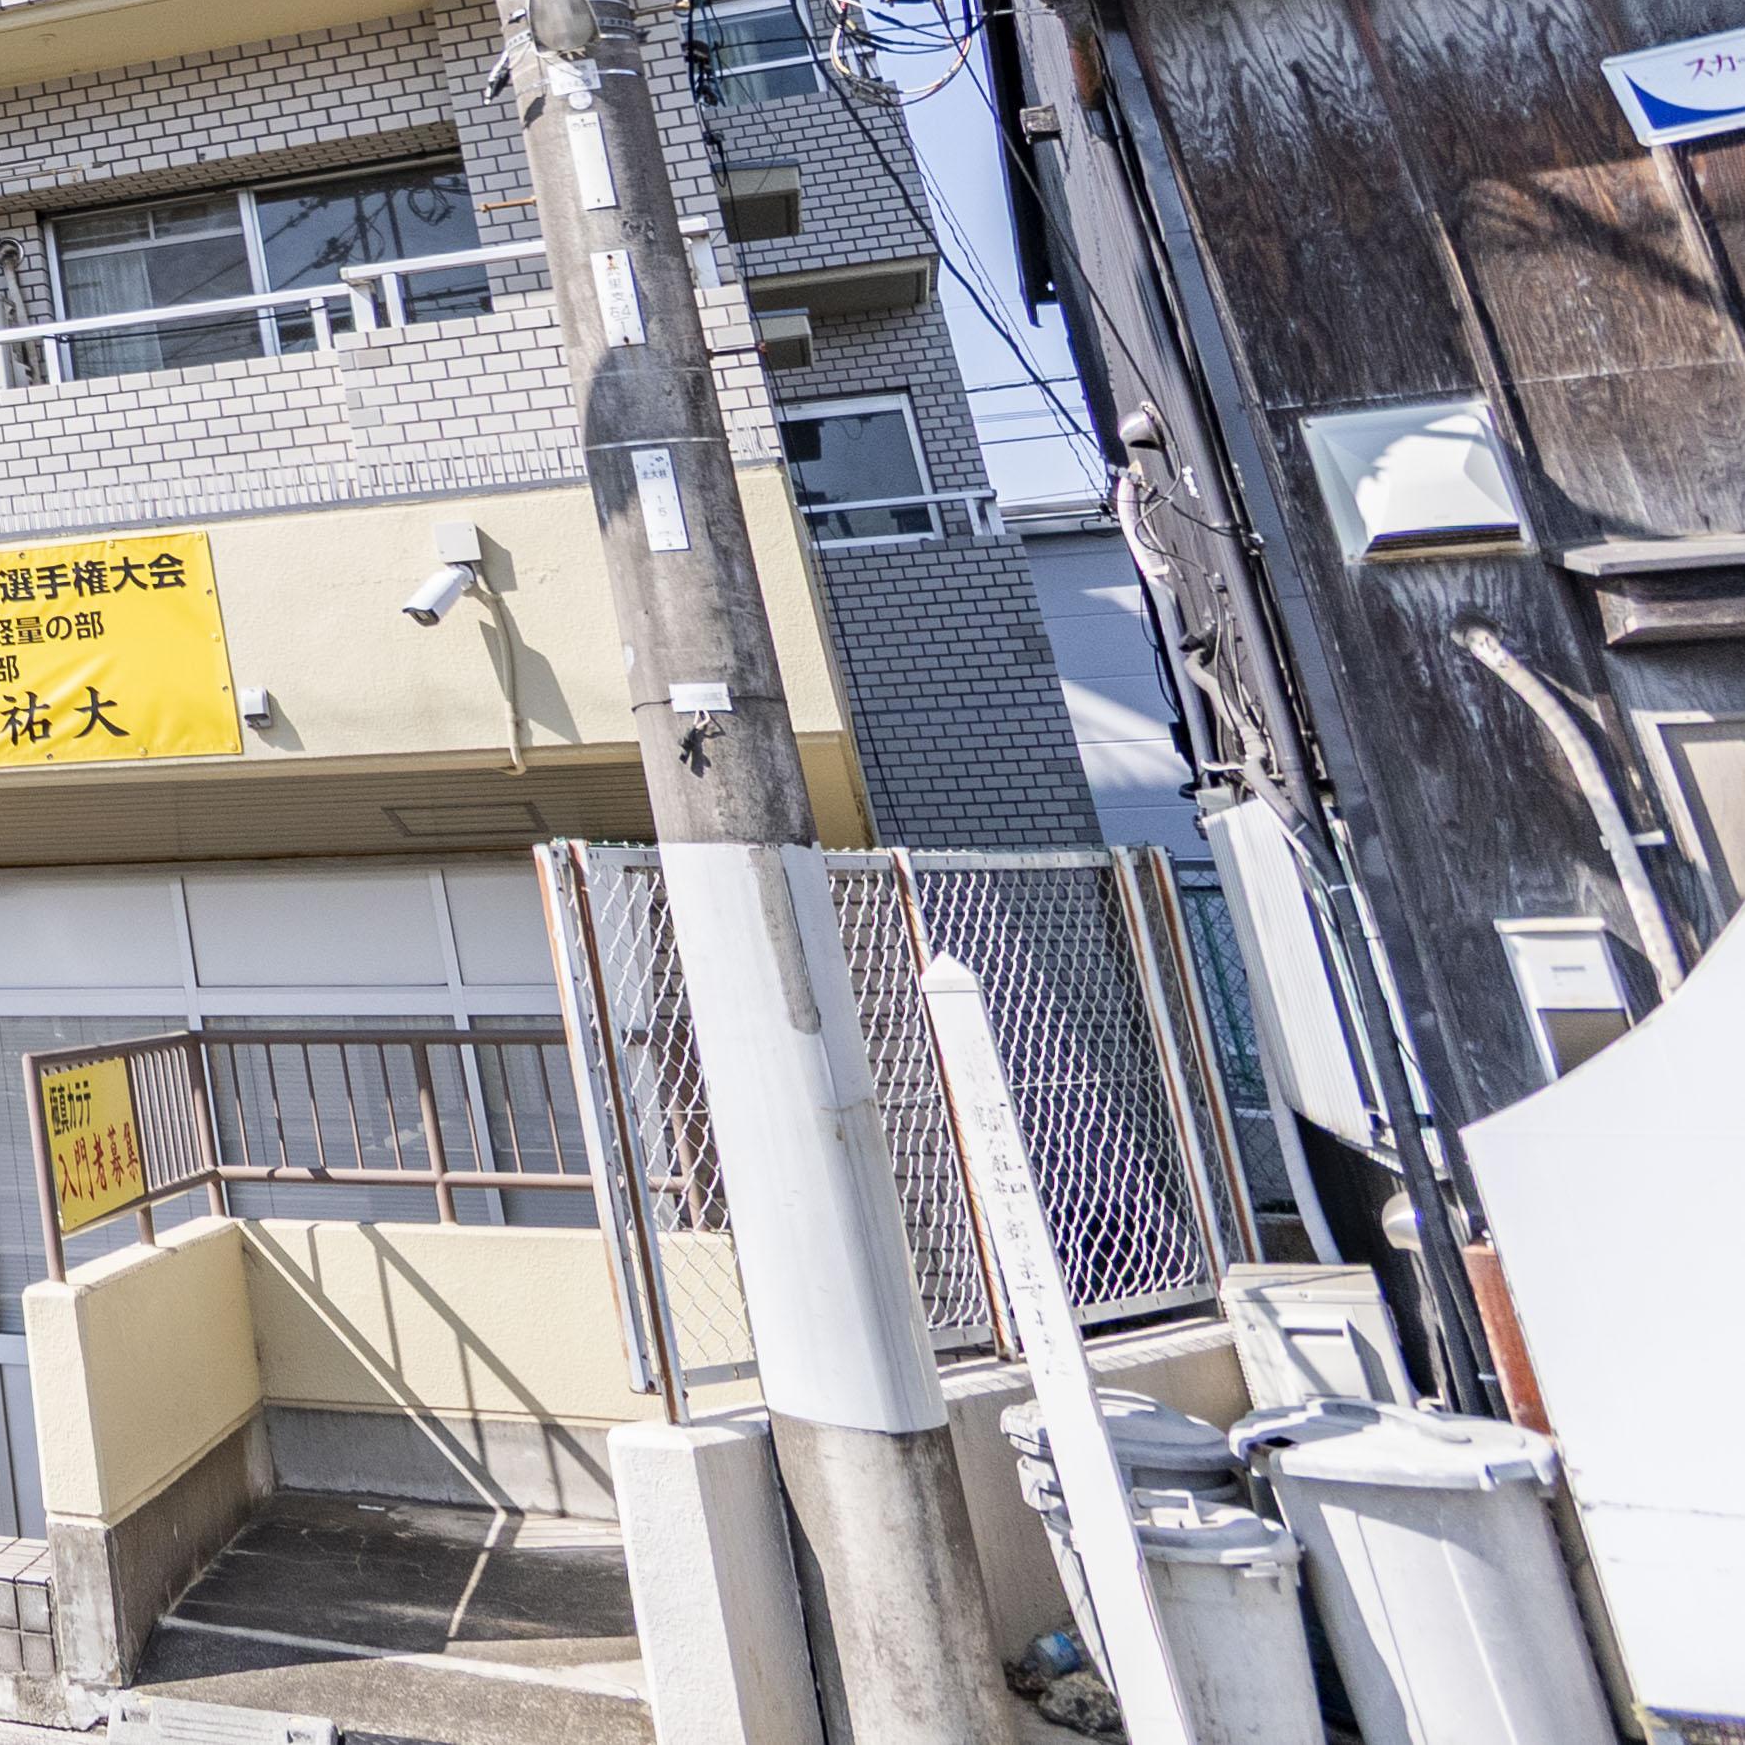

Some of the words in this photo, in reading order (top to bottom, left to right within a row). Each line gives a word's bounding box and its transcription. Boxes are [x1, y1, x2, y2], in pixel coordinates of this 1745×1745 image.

[1683, 53, 1745, 82] スカ
[58, 1121, 139, 1205] 入門者募集
